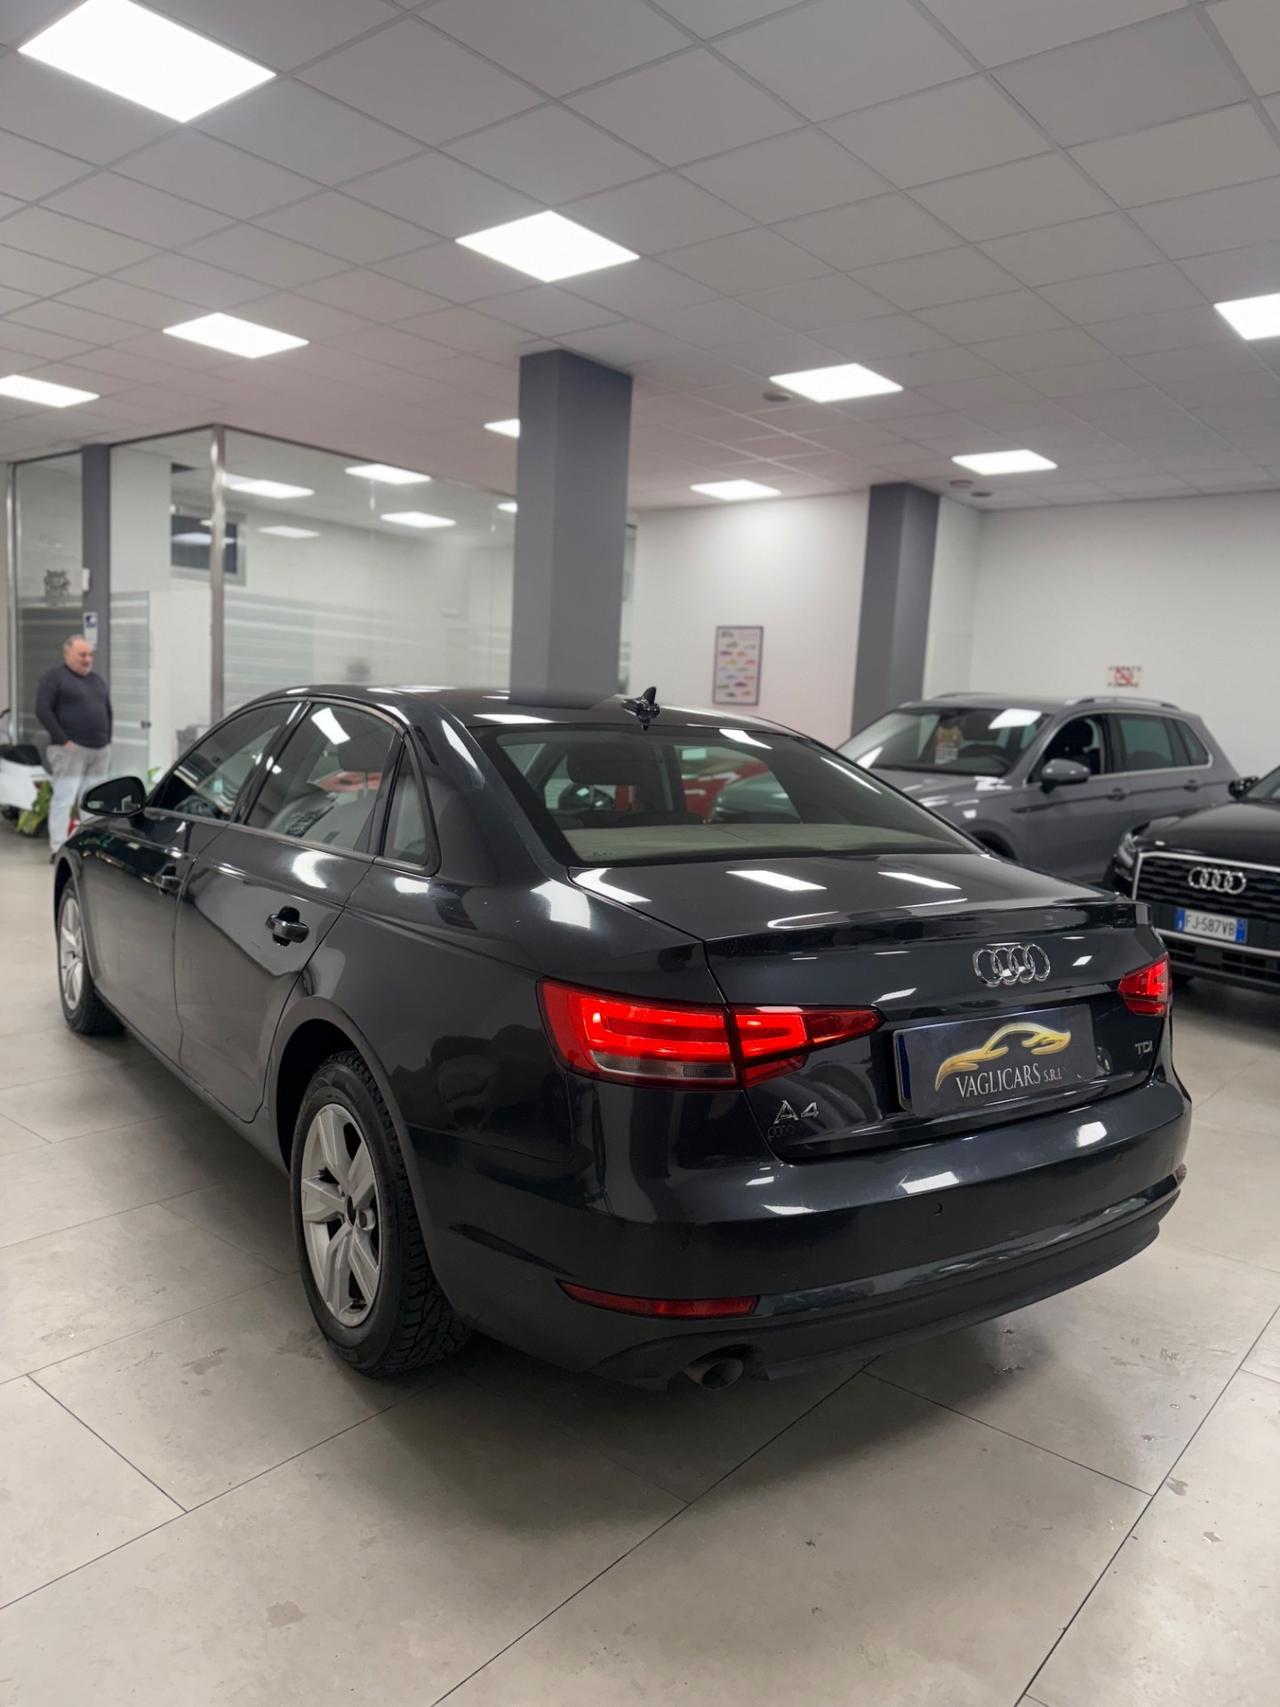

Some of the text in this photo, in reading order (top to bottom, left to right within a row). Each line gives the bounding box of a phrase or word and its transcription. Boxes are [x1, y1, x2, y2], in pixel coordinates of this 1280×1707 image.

[1134, 1040, 1153, 1055] TDI
[956, 1062, 1041, 1098] VAGLICARS
[773, 1100, 819, 1125] A4
